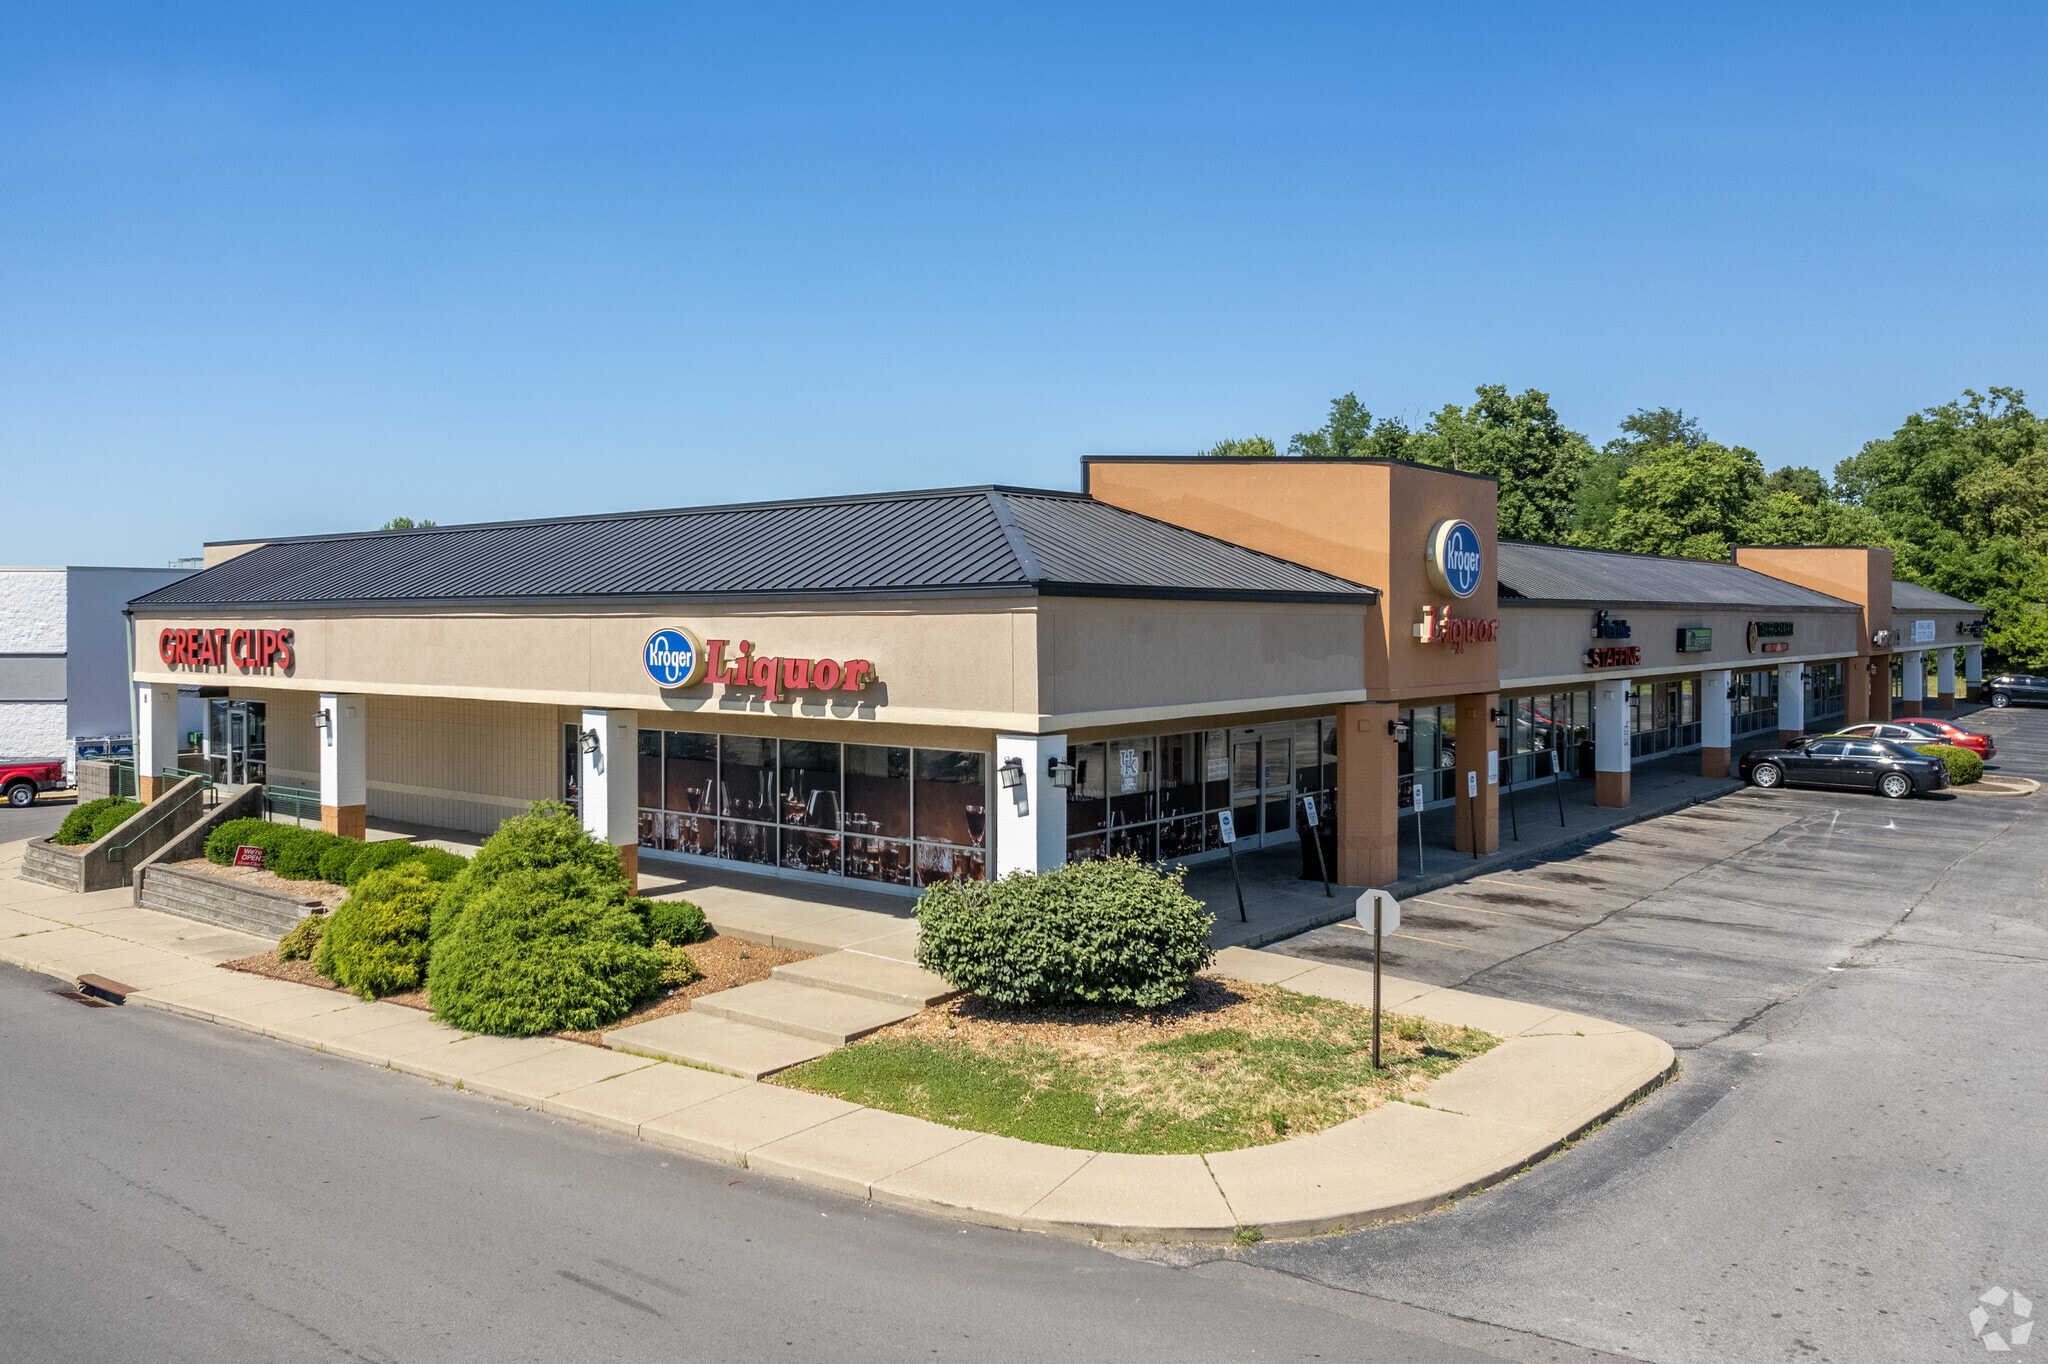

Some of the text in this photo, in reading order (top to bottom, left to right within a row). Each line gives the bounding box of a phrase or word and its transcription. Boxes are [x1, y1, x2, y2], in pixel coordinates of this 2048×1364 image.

[1447, 531, 1480, 590] Kroger
[159, 627, 291, 670] GREAT CLIPS
[1420, 605, 1498, 655] Liquor
[649, 635, 872, 702] Kroger Liquor
[1590, 645, 1642, 669] STAFFING
